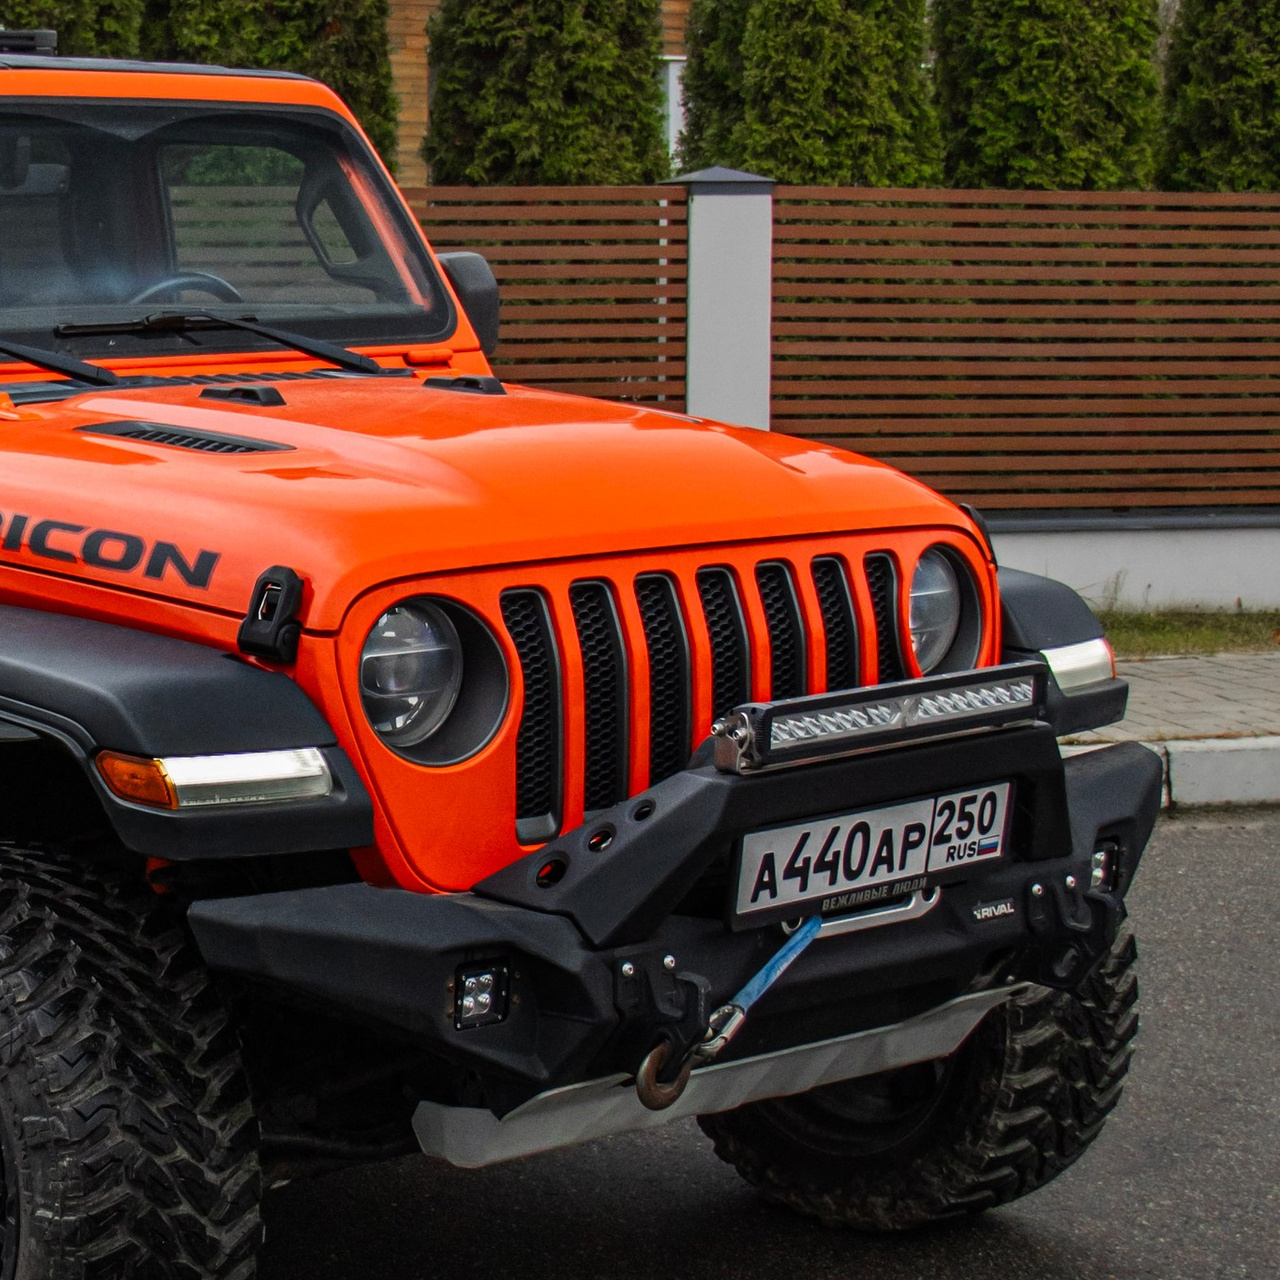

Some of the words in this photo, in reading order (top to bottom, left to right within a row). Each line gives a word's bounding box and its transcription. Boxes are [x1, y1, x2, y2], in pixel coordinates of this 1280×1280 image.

[933, 791, 997, 846] 250
[946, 840, 977, 863] RUS
[821, 885, 889, 911] ВЕЖЛИВЫЕ
[892, 876, 928, 898] ЛЮДИ
[981, 902, 1015, 919] RIVAL
